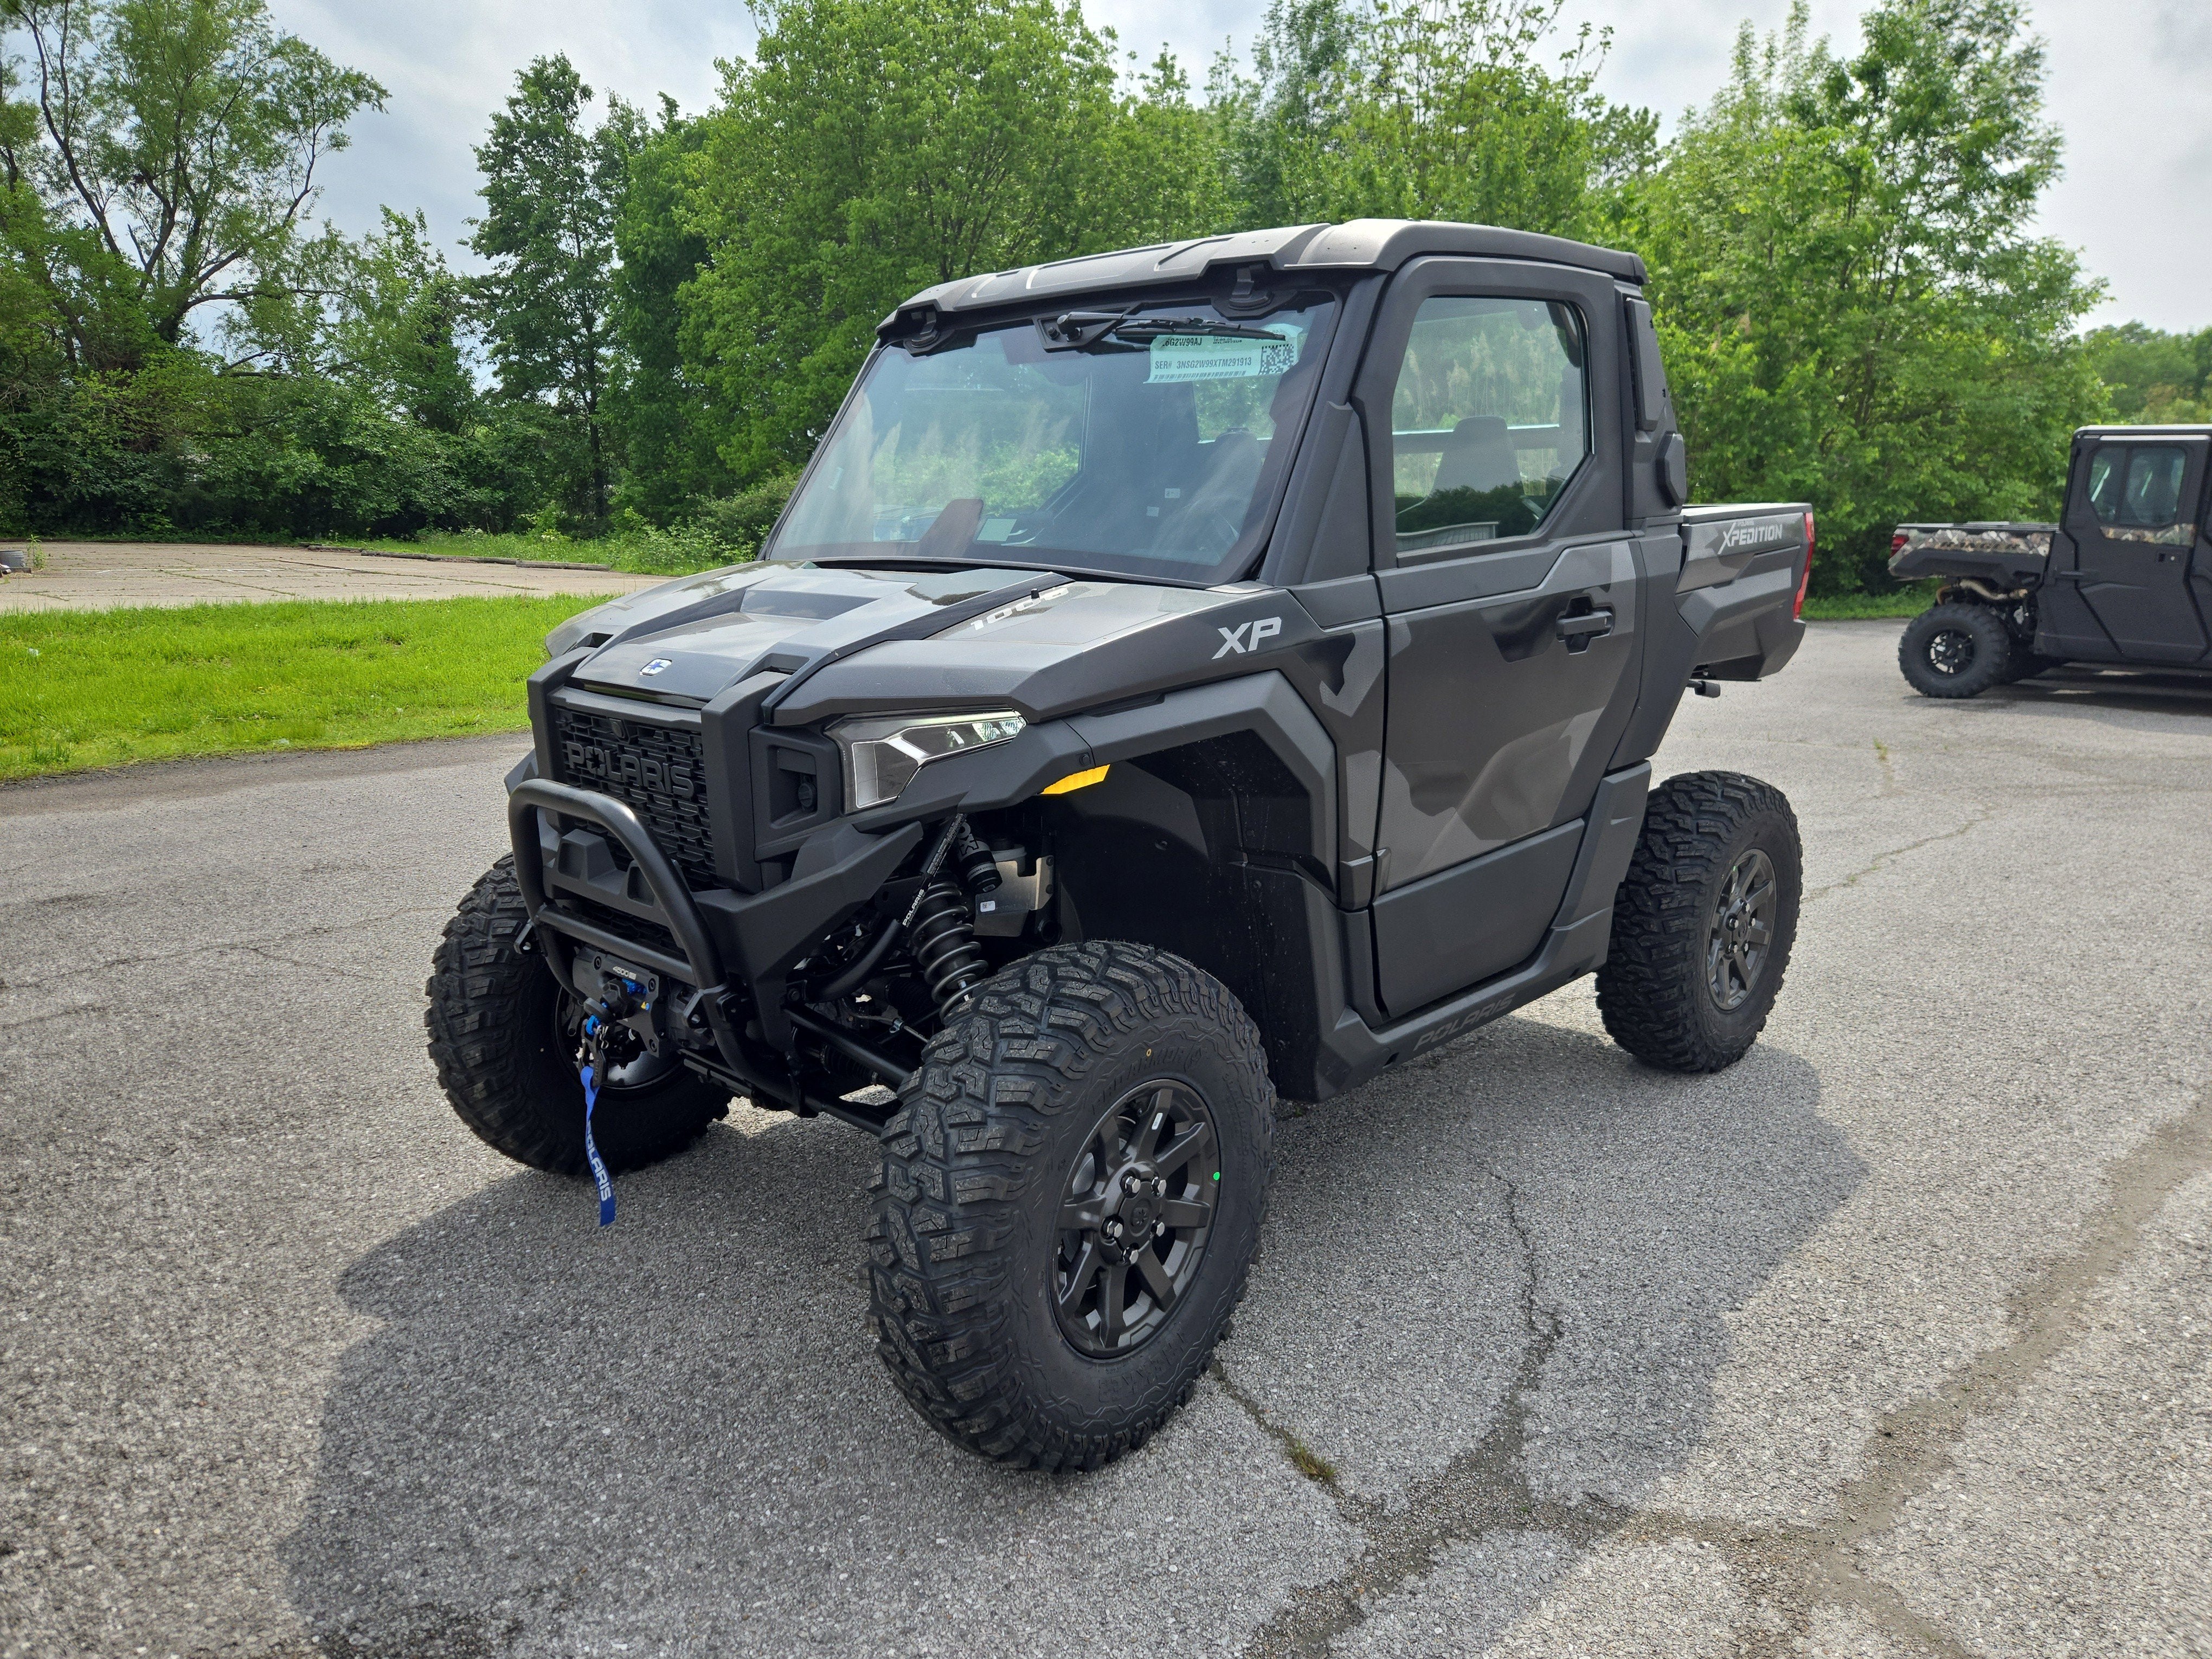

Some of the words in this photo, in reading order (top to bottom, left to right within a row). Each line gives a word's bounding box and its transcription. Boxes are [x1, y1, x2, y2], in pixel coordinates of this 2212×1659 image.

[1155, 361, 1172, 370] SER#
[1717, 521, 1783, 555] XPEDITION
[970, 587, 1069, 631] 1000
[1211, 616, 1282, 660] XP
[566, 741, 695, 800] POLARIS
[902, 889, 924, 926] POLARIS
[613, 966, 629, 977] 4500
[1413, 992, 1516, 1052] POLARIS
